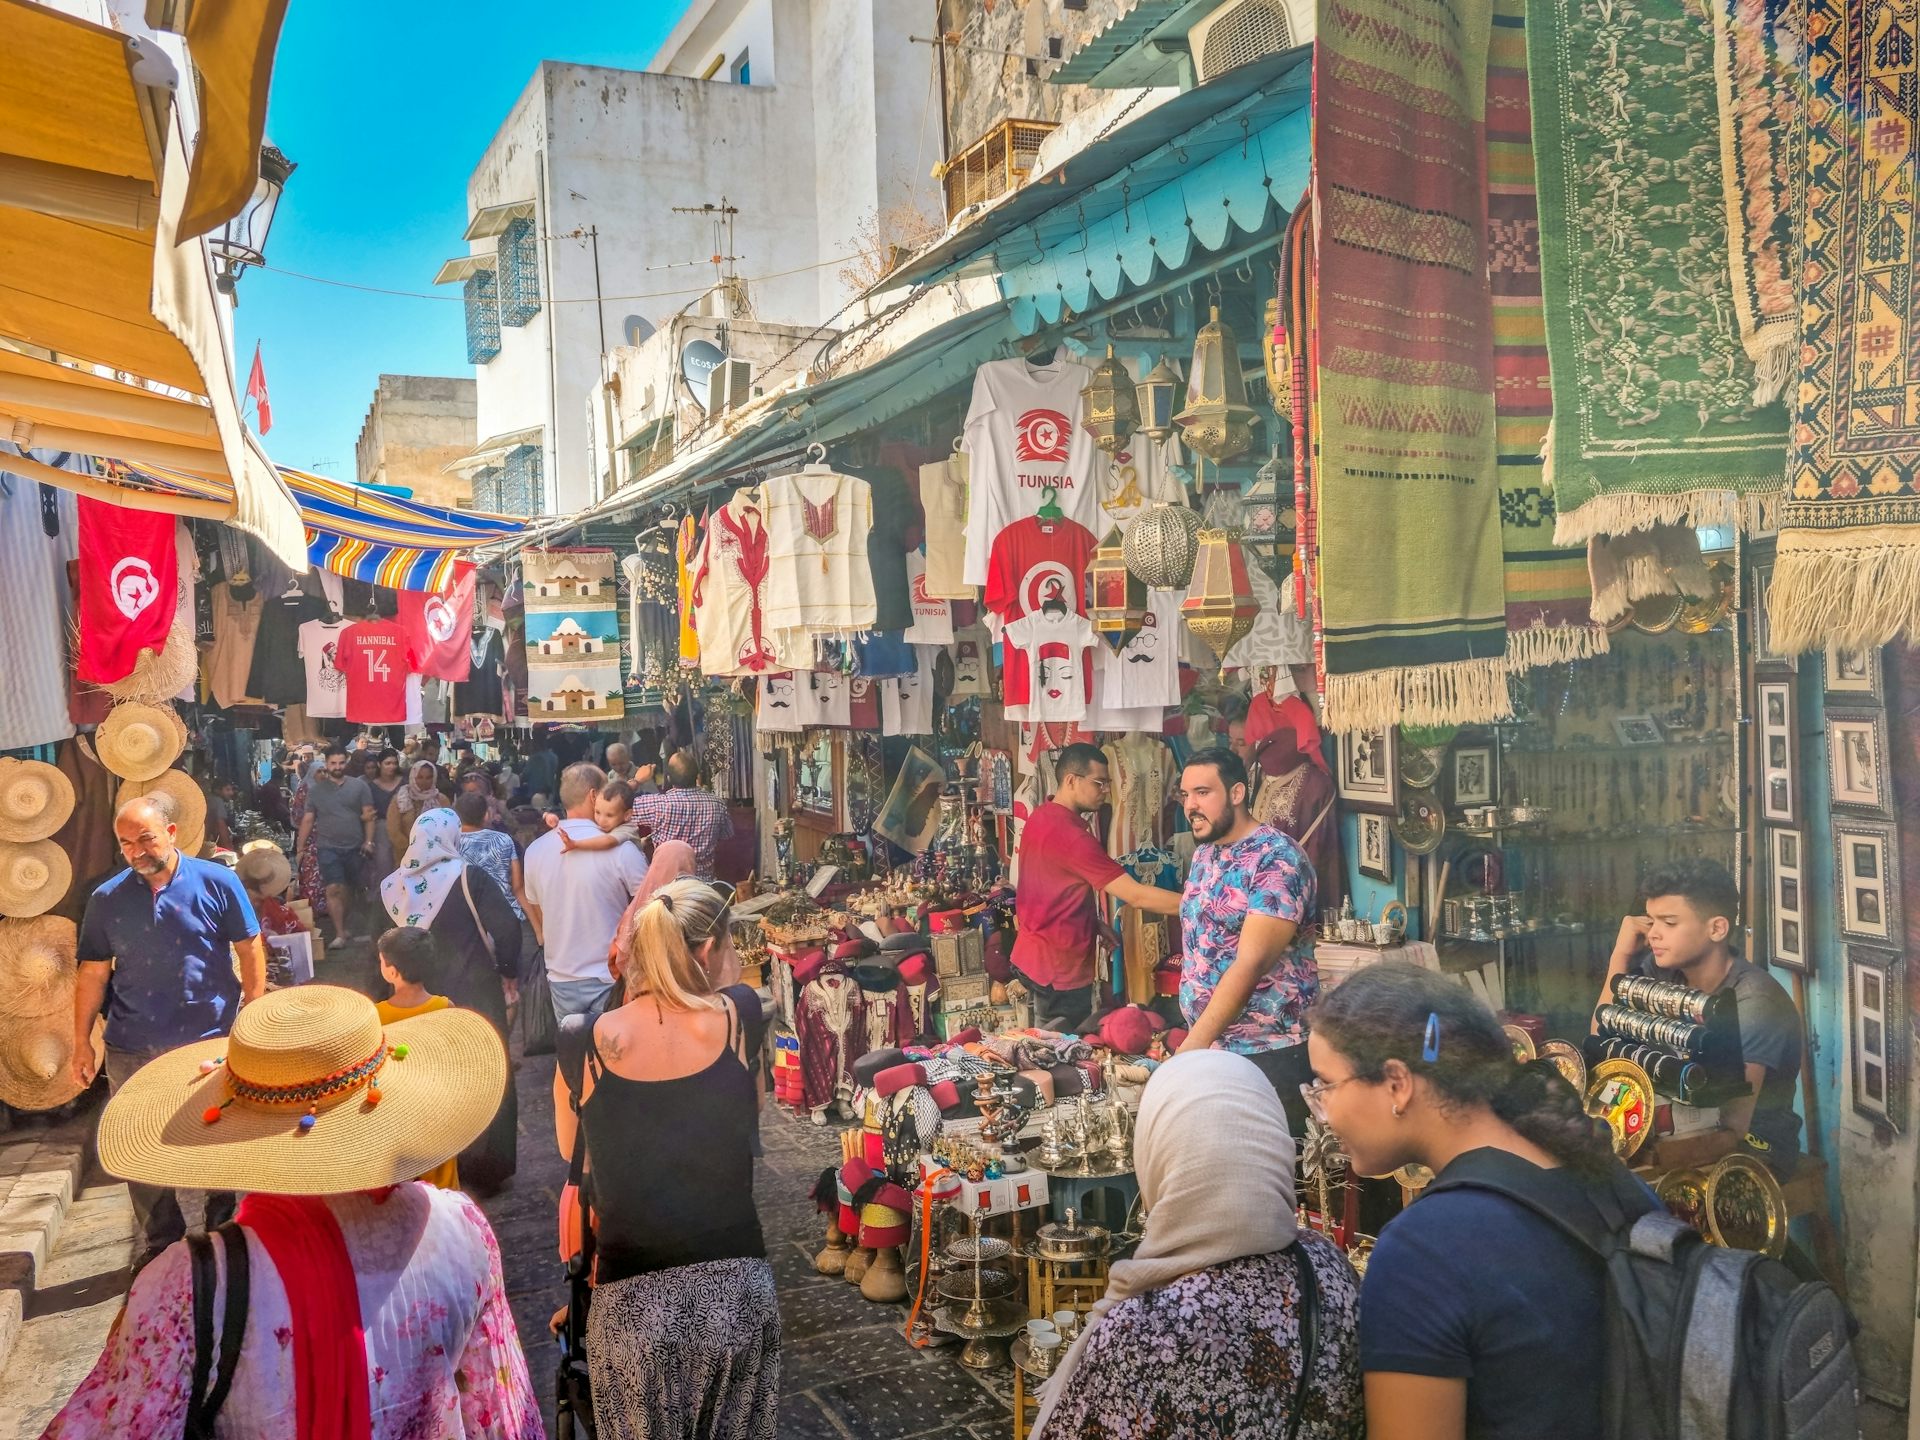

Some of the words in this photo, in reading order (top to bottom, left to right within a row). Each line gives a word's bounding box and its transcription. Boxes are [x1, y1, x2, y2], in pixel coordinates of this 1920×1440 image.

[1017, 474, 1075, 489] TUNISIA
[914, 608, 947, 616] TUNISIA
[356, 635, 397, 646] HANNIBAL
[362, 649, 391, 682] 14
